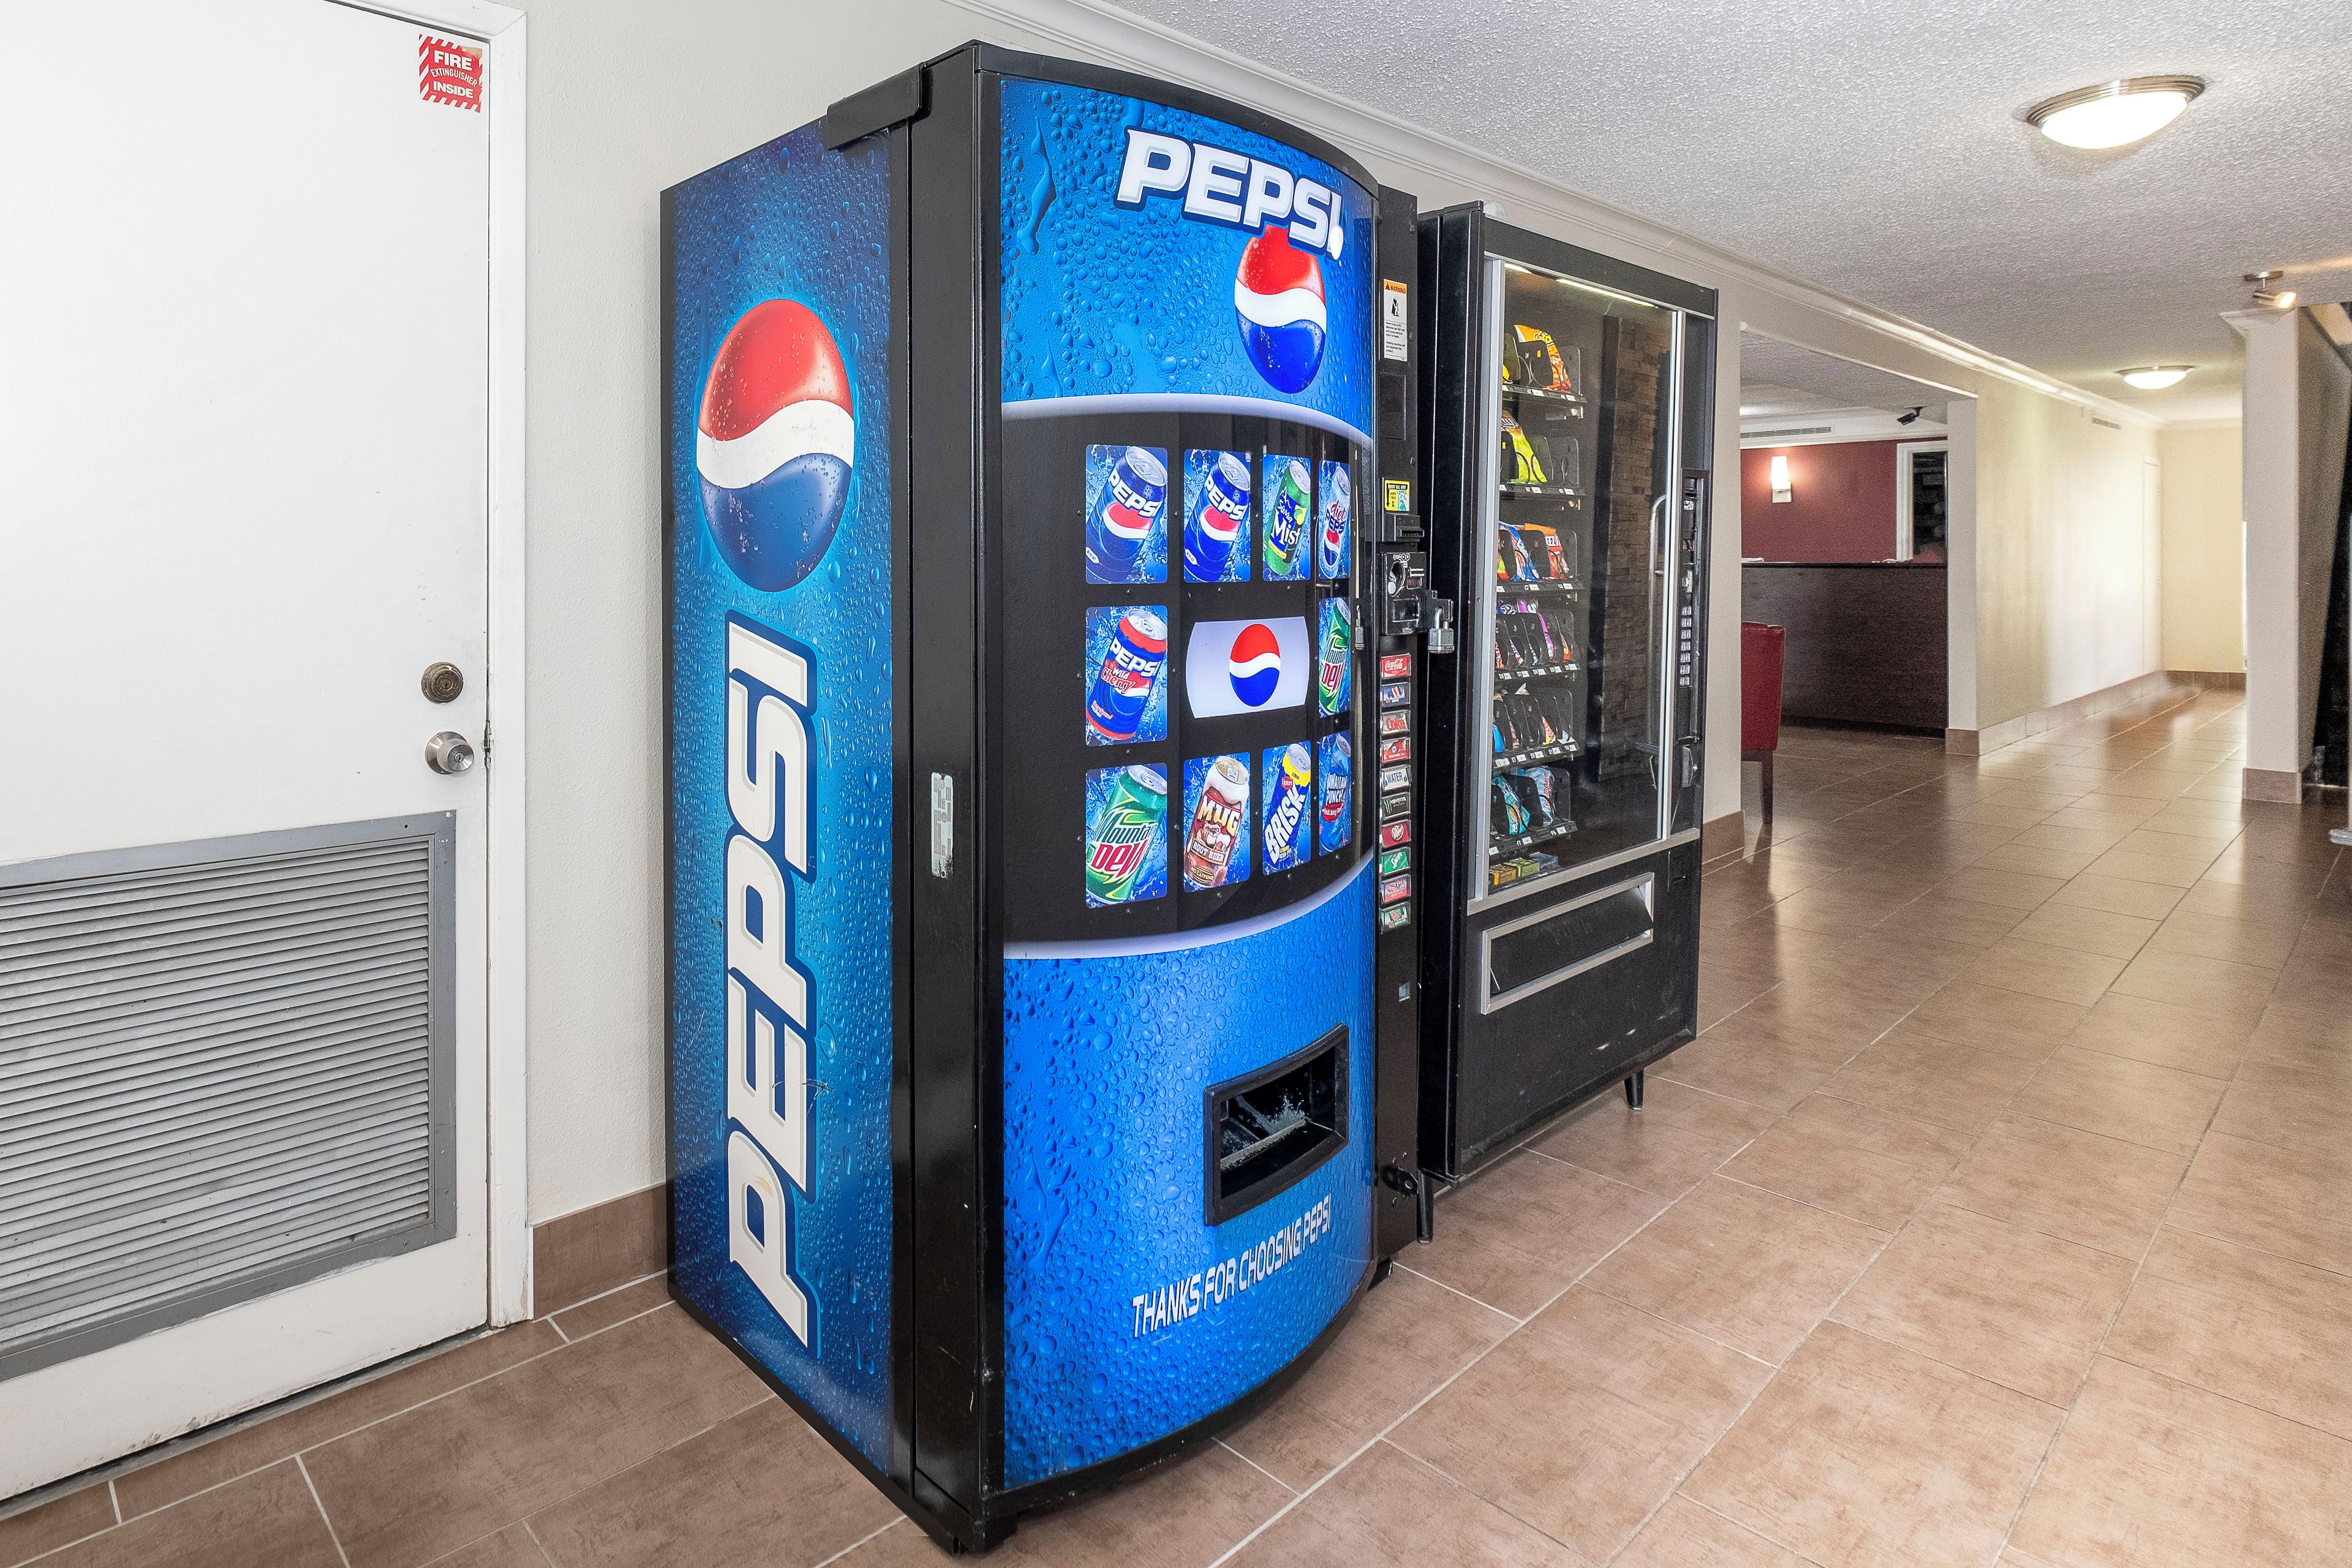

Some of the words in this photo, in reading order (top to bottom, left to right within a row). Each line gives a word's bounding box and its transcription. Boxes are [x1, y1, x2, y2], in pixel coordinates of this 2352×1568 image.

[434, 50, 472, 71] FIRE
[430, 67, 477, 88] EXTINGUISHER
[433, 80, 473, 99] INSIDE
[1115, 127, 1344, 256] PEPSI
[1108, 469, 1161, 518] PEPSI
[1204, 473, 1247, 521] PEPSI
[1277, 499, 1293, 523] Sierra
[1324, 508, 1347, 534] PEPS
[1331, 499, 1346, 521] diet
[1270, 507, 1302, 545] Mist
[1109, 636, 1162, 677] PEPSI
[1101, 666, 1136, 694] Cherry
[1112, 668, 1130, 679] Wild
[1386, 772, 1403, 784] WATER
[1197, 794, 1241, 837] MUG
[1265, 782, 1306, 864] BRISK
[1193, 840, 1208, 856] ROOT
[1208, 850, 1224, 862] BEER
[727, 620, 809, 1349] PEPSI
[1133, 1273, 1201, 1337] THANKS
[1203, 1257, 1237, 1310] FOR
[1238, 1219, 1302, 1290] CHOOSING
[1303, 1193, 1332, 1251] PEPSI
